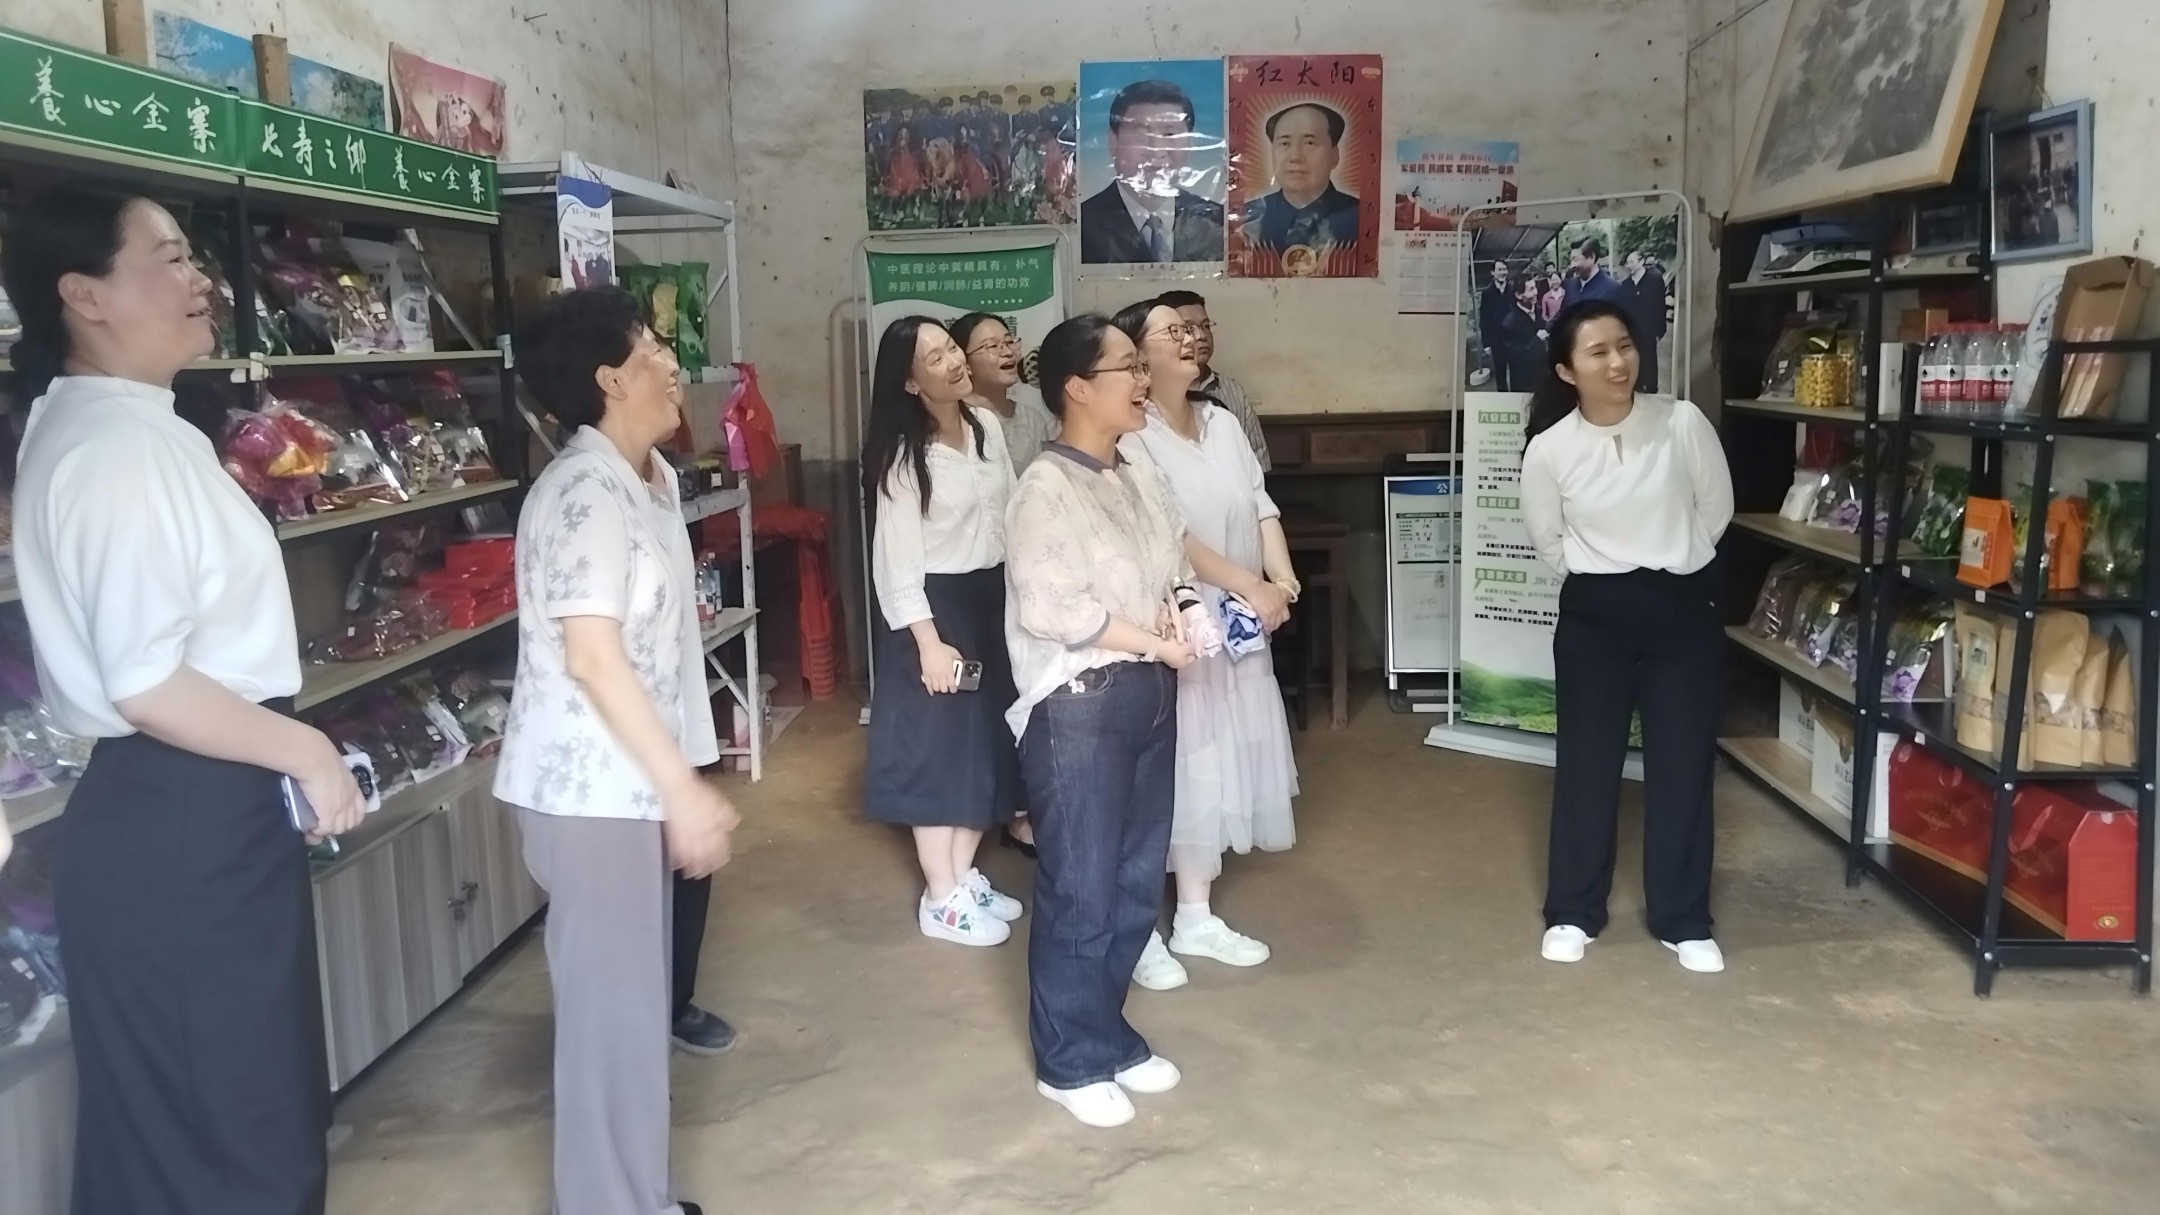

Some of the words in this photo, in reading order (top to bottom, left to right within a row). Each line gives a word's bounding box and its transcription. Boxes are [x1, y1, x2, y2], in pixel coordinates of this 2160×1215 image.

[1255, 59, 1355, 87] 红太阳
[1533, 576, 1547, 585] JIN
